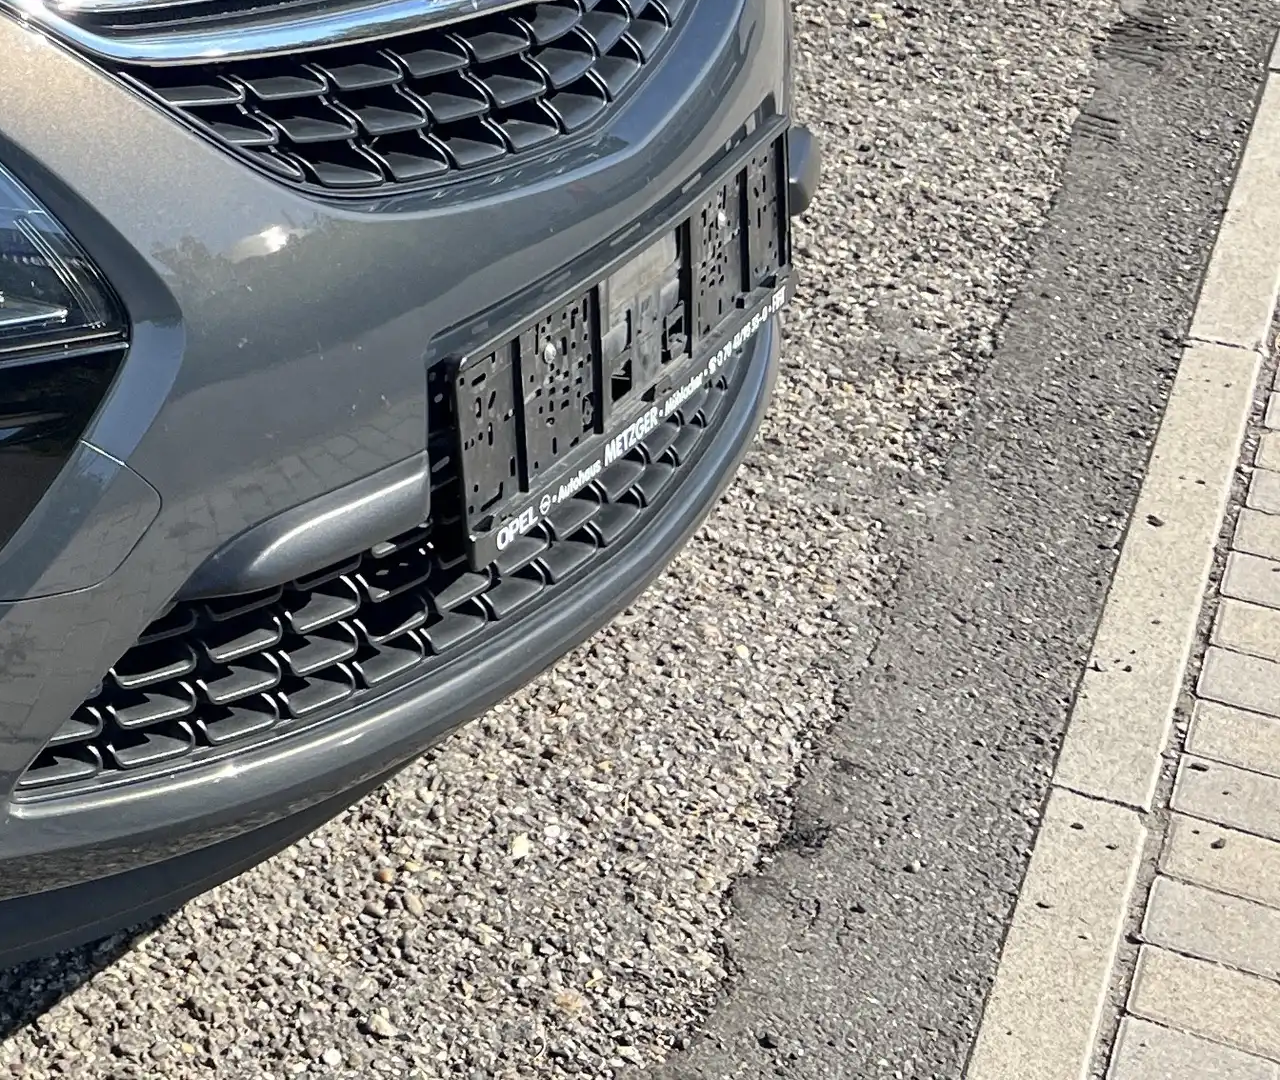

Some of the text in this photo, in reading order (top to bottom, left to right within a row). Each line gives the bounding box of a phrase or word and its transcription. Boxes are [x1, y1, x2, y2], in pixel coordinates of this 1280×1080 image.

[496, 506, 539, 551] OPEL
[557, 459, 602, 504] Autohaus
[604, 406, 658, 467] METZGER
